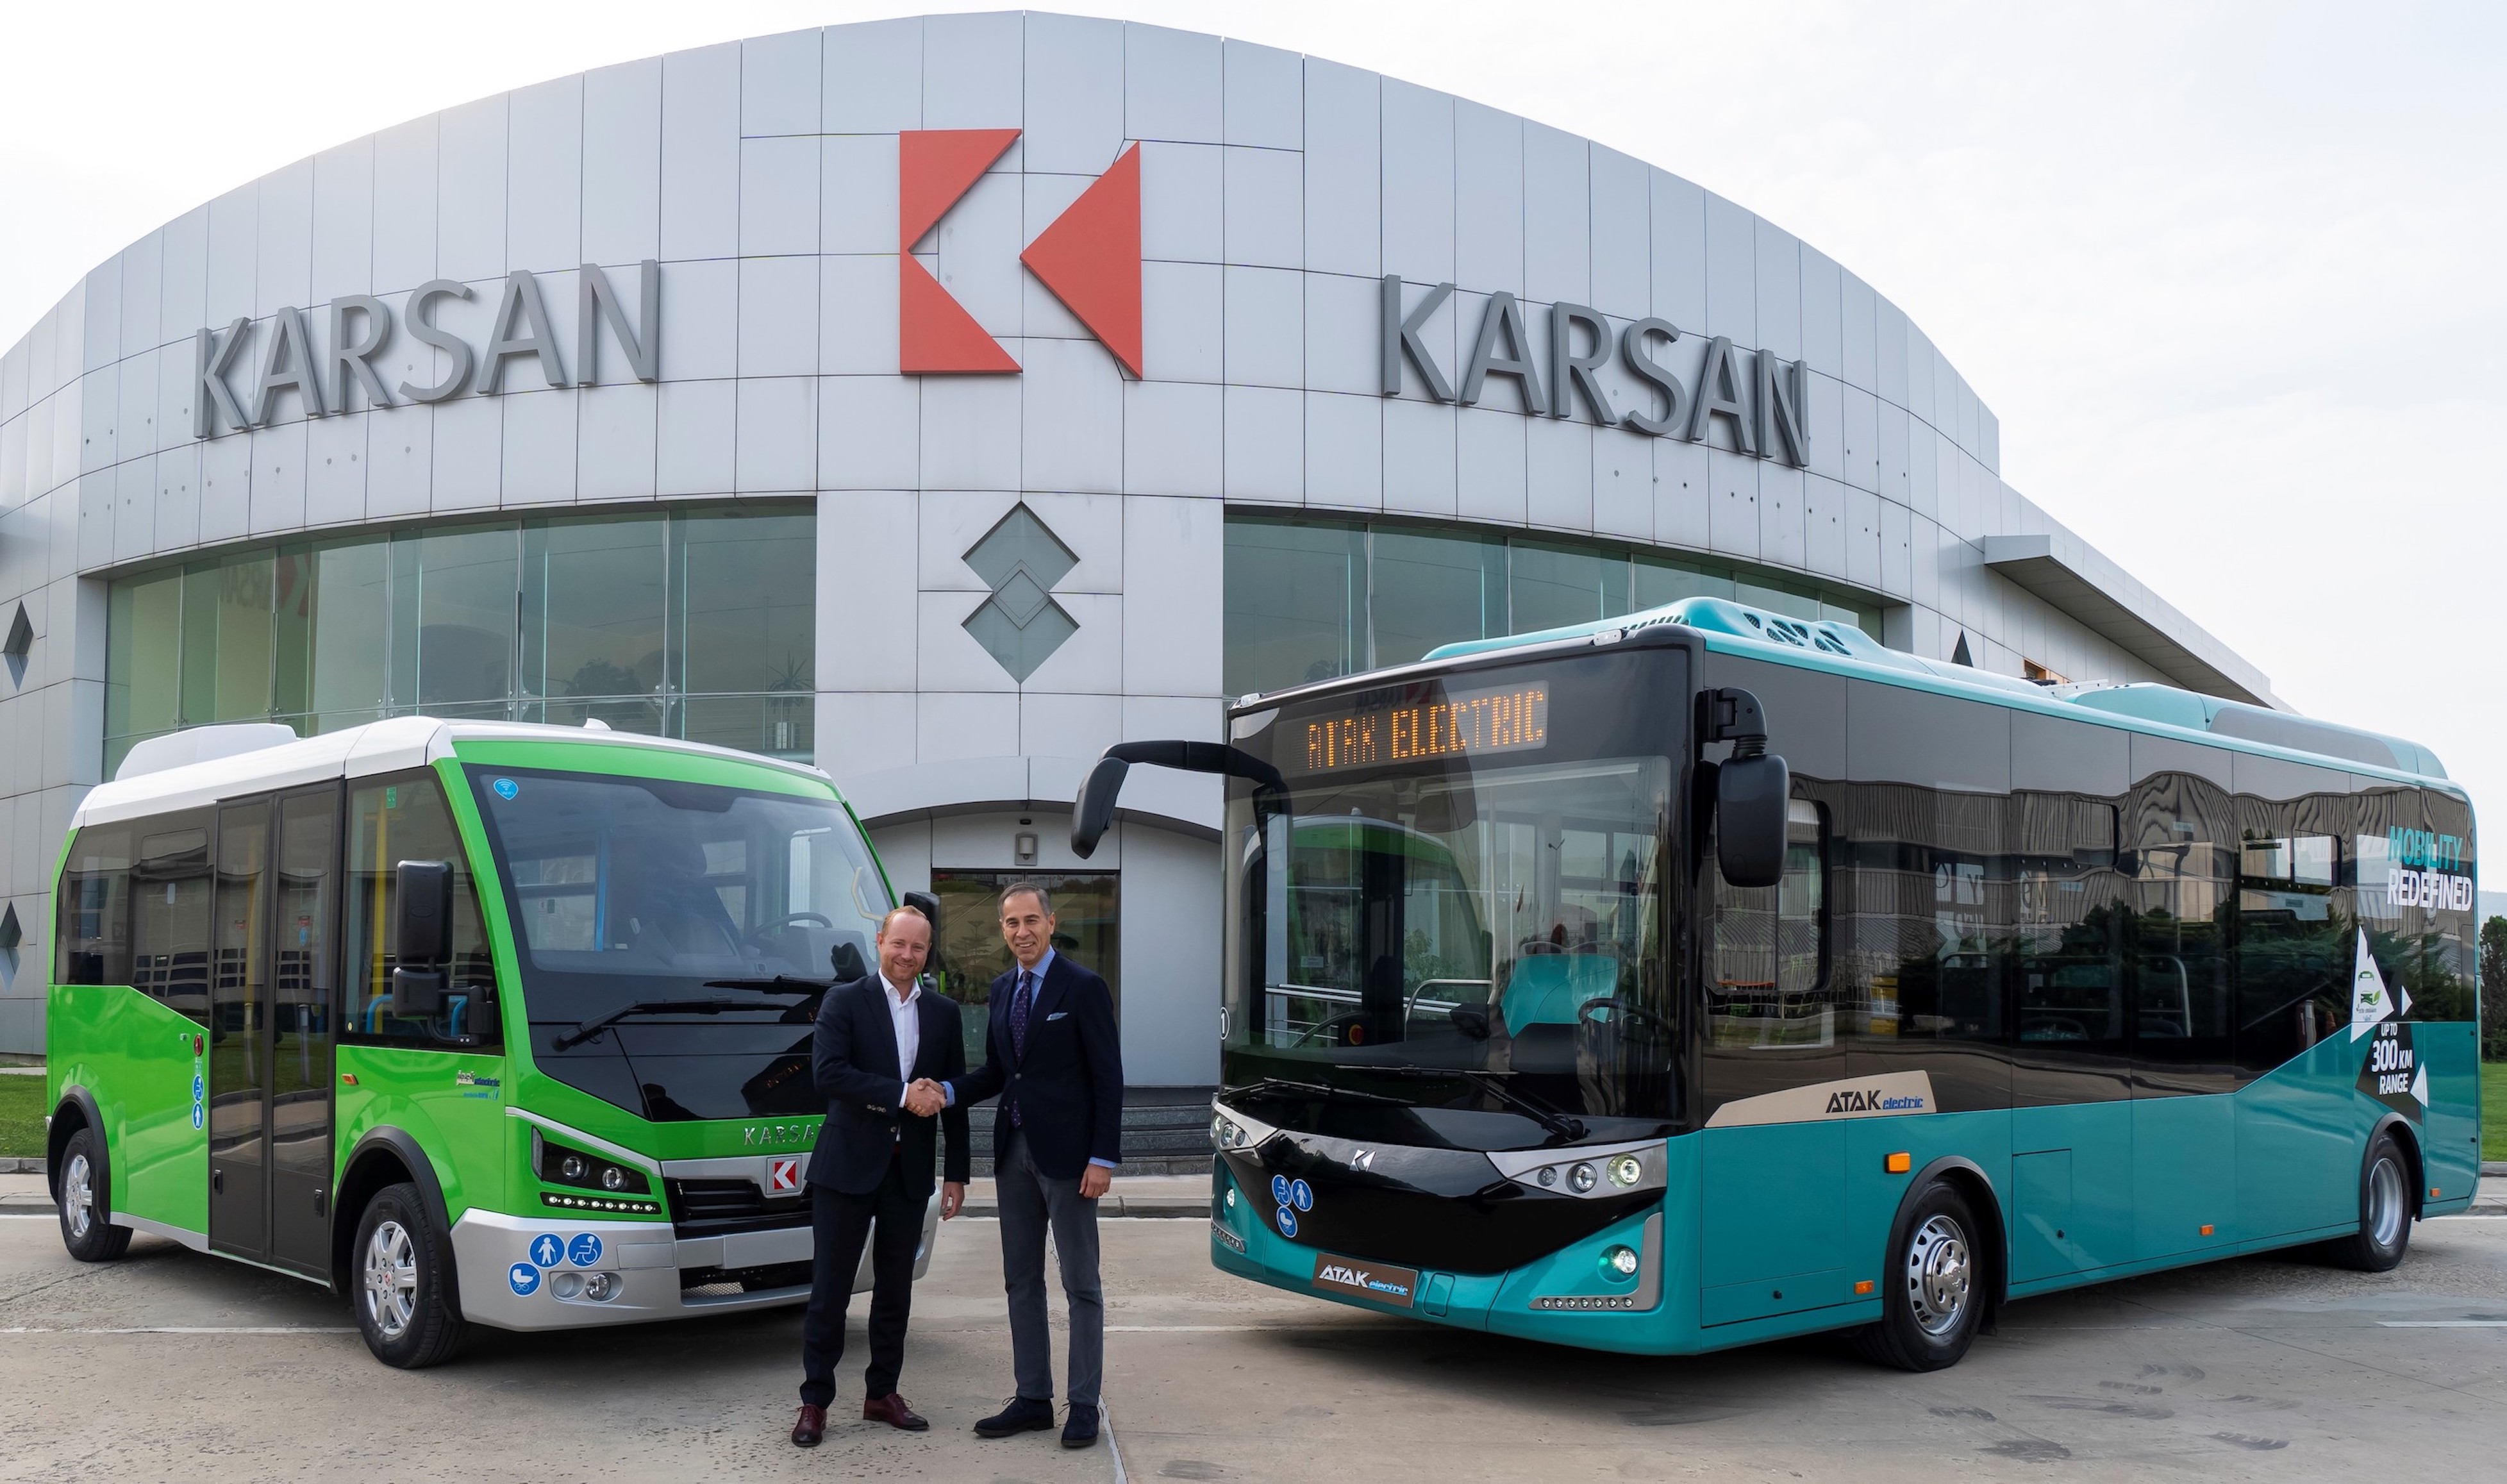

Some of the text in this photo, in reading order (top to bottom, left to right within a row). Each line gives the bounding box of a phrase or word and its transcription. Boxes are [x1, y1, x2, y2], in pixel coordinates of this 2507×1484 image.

[194, 259, 658, 439] KARSAN
[1383, 274, 1810, 467] KARSAN
[1308, 691, 1544, 769] ATAK ELECTRIC
[2388, 826, 2463, 871] MOBILITY
[2387, 869, 2473, 912] REDEFINED
[2381, 1023, 2398, 1037] UP TO
[2372, 1039, 2413, 1072] 300 KM
[2379, 1073, 2408, 1095] RANGE
[1826, 1090, 1923, 1113] ATAK electric
[744, 1124, 822, 1146] KARSA
[1319, 1263, 1409, 1296] ATAK electric
